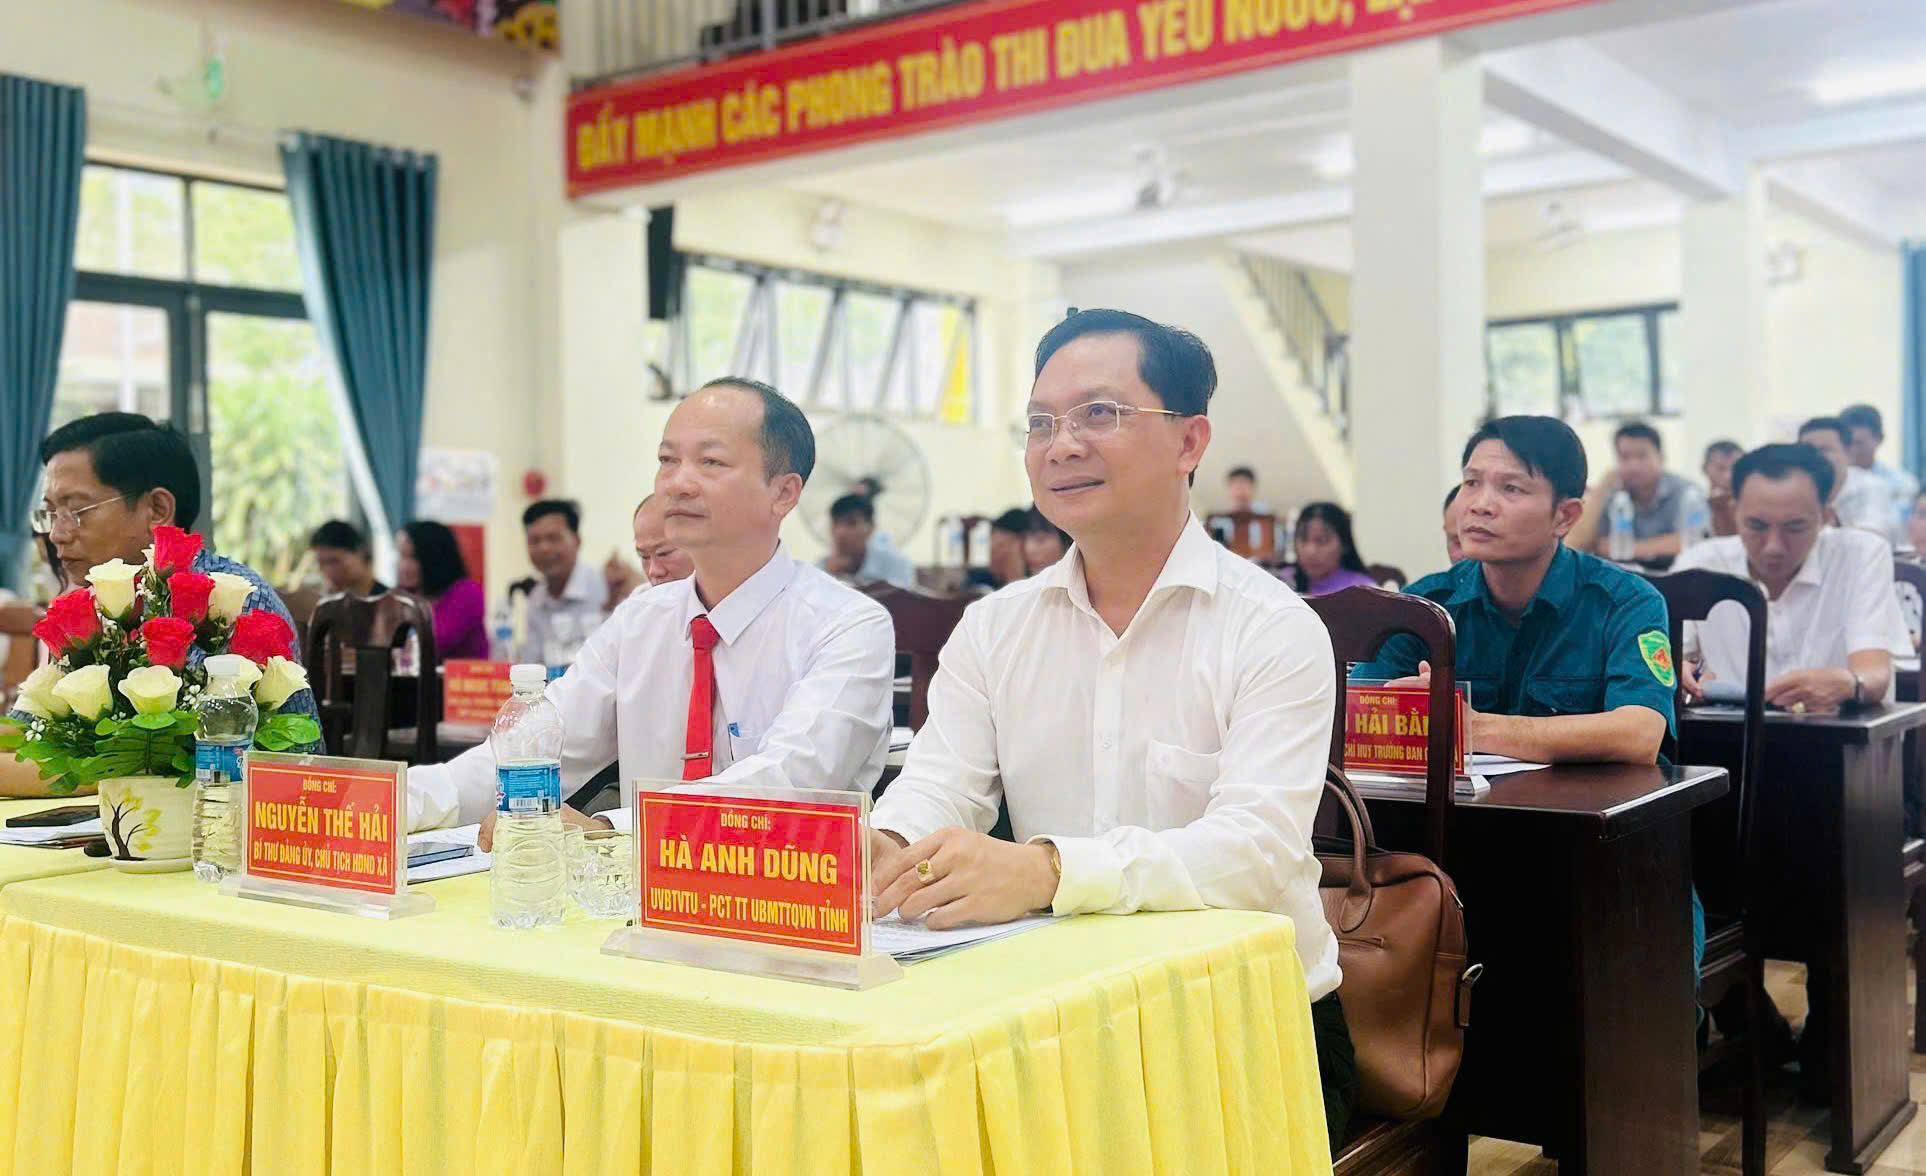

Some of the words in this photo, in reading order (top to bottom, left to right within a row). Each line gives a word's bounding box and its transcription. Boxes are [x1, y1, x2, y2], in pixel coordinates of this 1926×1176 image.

[721, 82, 781, 143] CÁC
[786, 61, 892, 131] PHONG
[897, 36, 985, 111] TRÀO
[991, 27, 1049, 92] THI
[1055, 10, 1131, 79] ĐUA
[1355, 707, 1389, 735] HẢI
[1357, 744, 1371, 758] HUY
[1406, 746, 1423, 760] BAN
[255, 796, 318, 834] NGUYỄN
[324, 802, 354, 839] THẾ
[359, 803, 388, 842] HẢI
[751, 813, 771, 831] CHÍ:
[254, 837, 263, 861] BÍ
[264, 841, 279, 862] THƯ
[279, 838, 301, 865] ĐẢNG
[315, 843, 331, 869] CHỦ
[333, 850, 351, 875] TỊCH
[660, 835, 693, 870] HÀ
[700, 843, 755, 877] ANH
[763, 844, 838, 885] DŨNG
[650, 887, 699, 914] UVBTVTU
[709, 894, 731, 920] PCT
[735, 897, 748, 921] TT
[751, 898, 816, 930] UBMTTQVN
[819, 899, 849, 933] TỈNH
